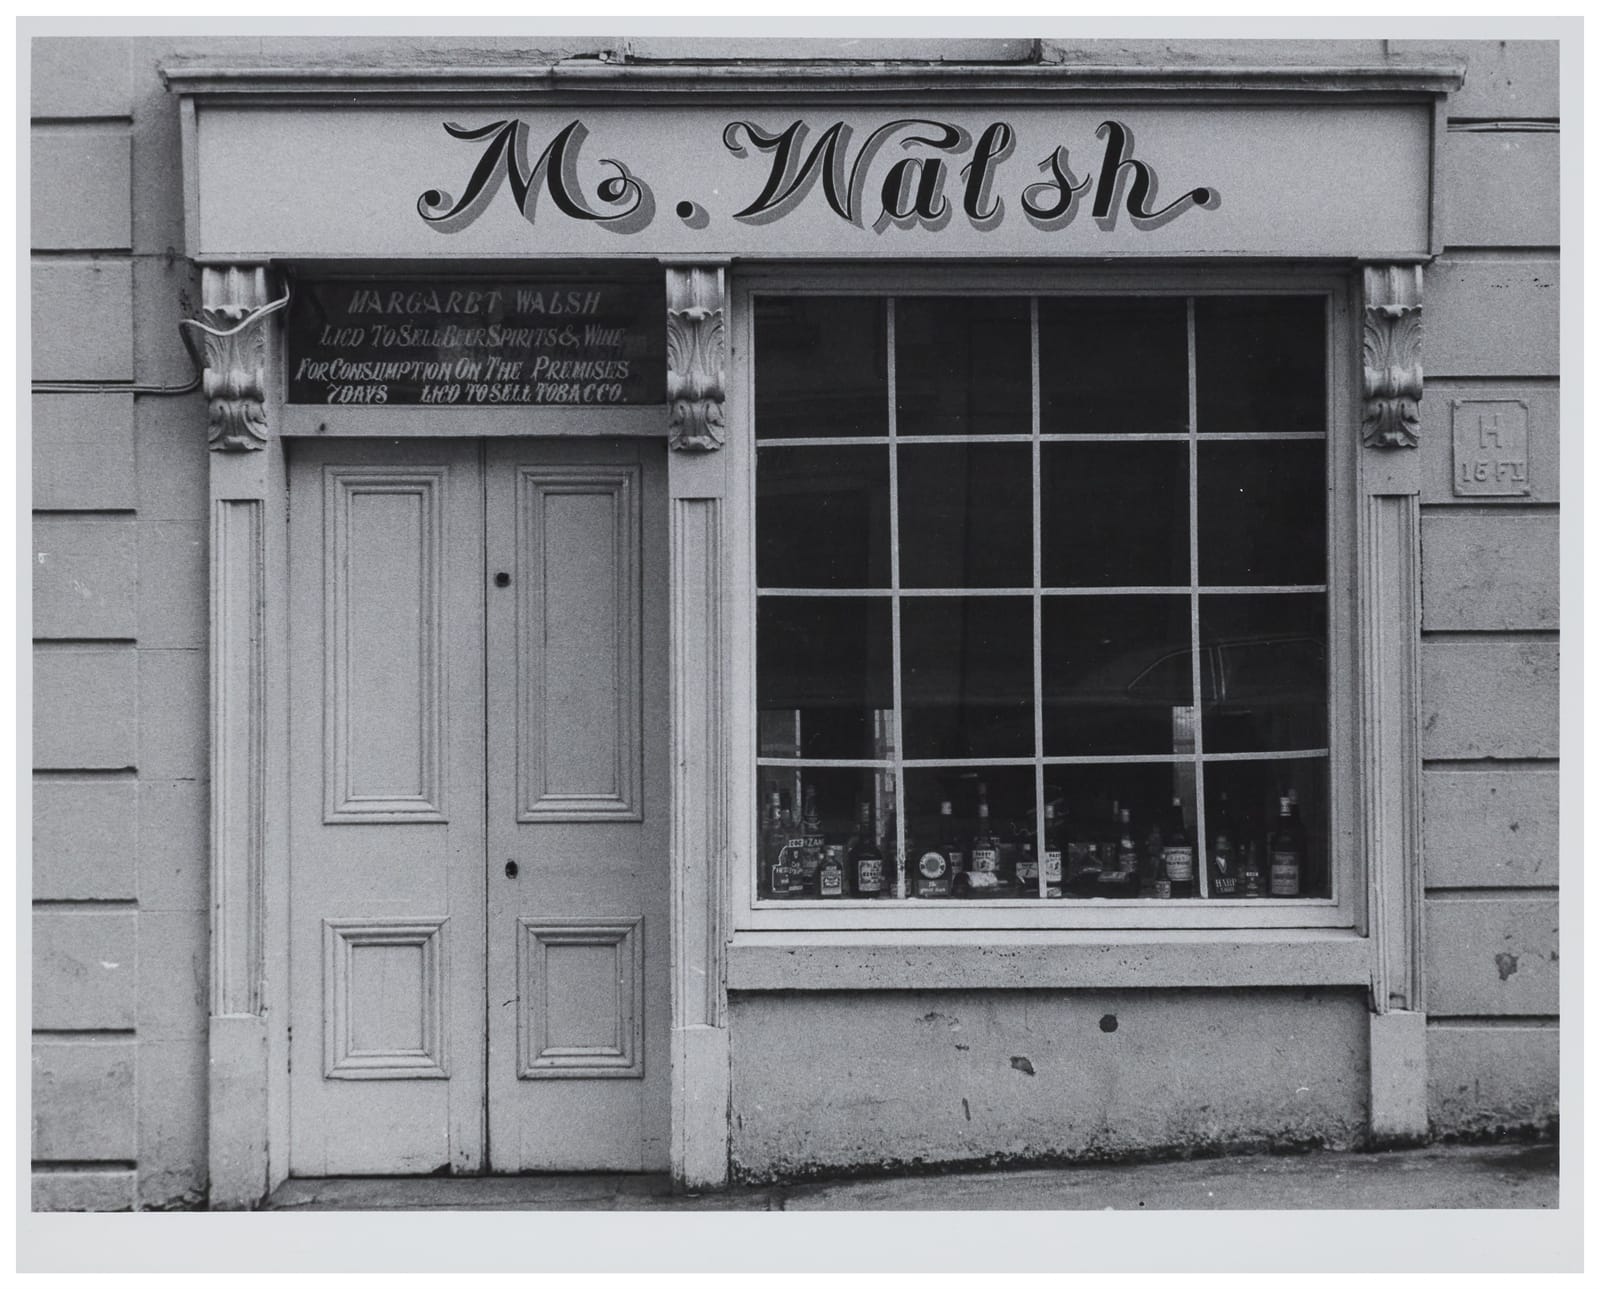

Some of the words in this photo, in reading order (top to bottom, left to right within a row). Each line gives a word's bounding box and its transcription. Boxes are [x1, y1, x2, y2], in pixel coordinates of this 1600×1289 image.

[416, 119, 709, 234] M.
[348, 290, 503, 314] MARGARET
[516, 290, 601, 315] WALSH
[530, 355, 631, 381] PREMISES
[1478, 411, 1503, 450] H
